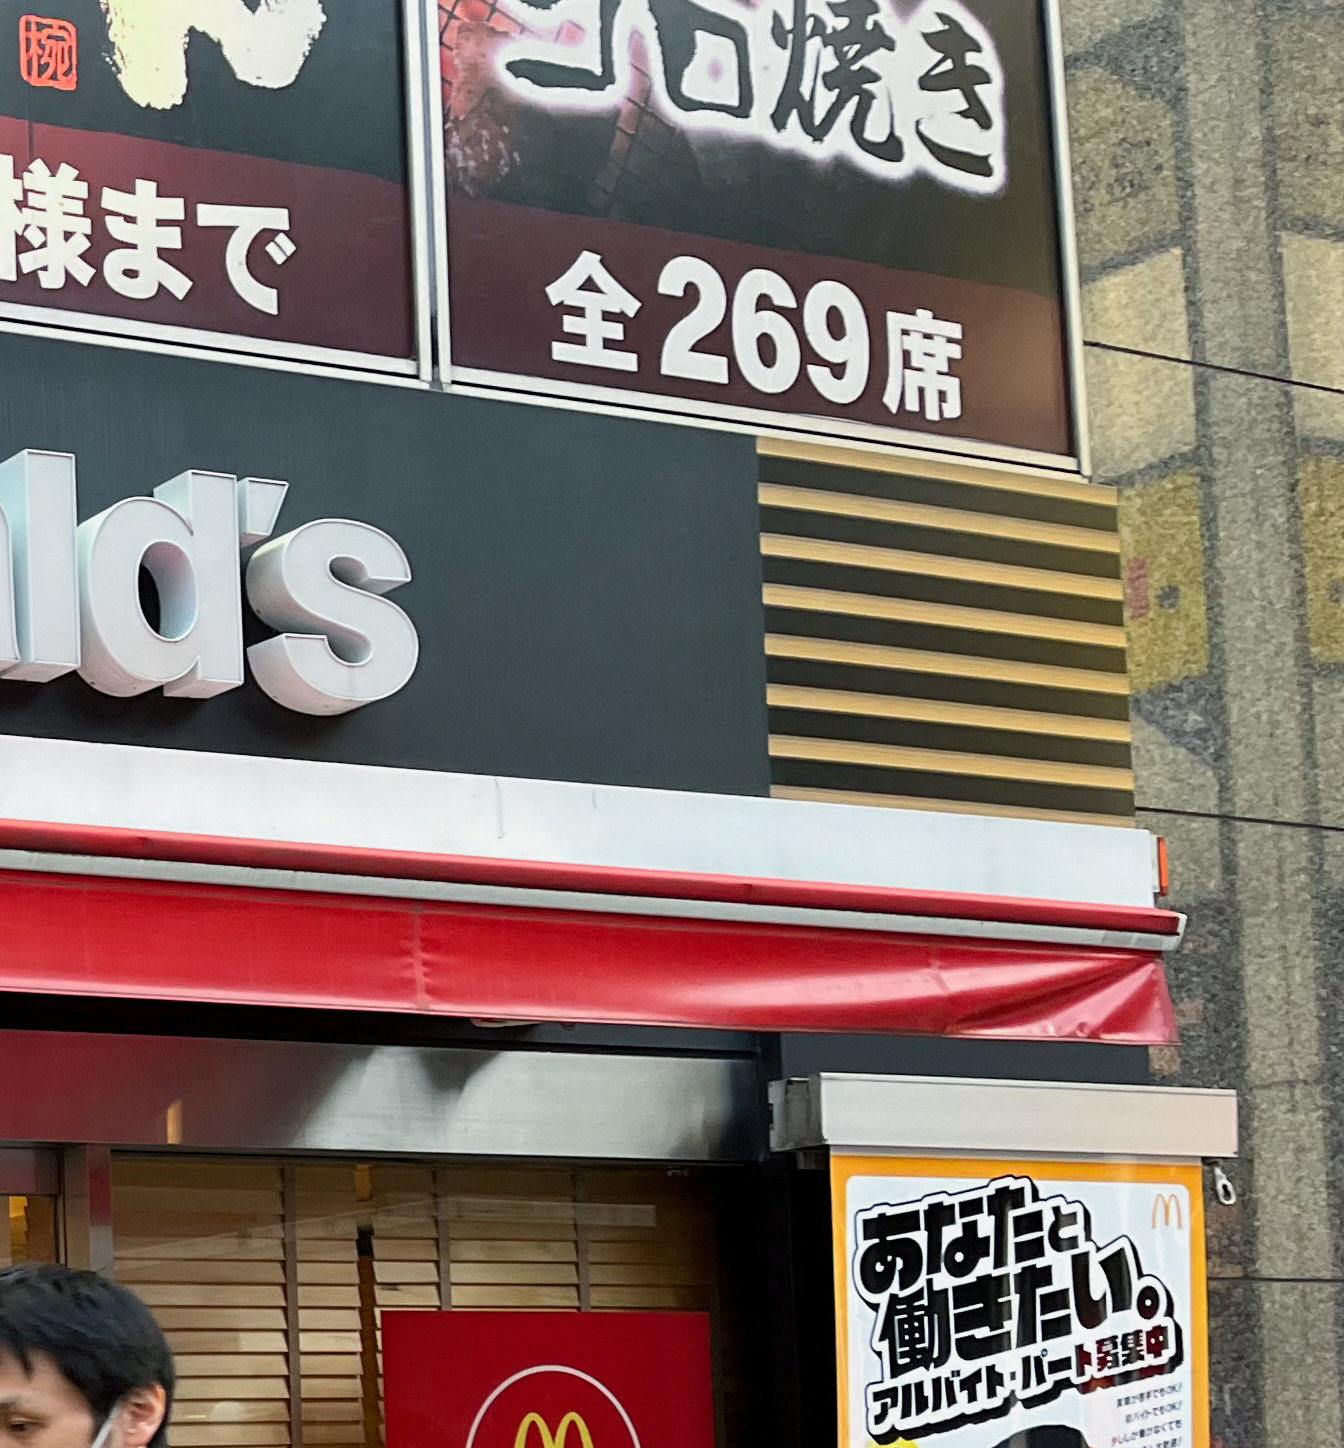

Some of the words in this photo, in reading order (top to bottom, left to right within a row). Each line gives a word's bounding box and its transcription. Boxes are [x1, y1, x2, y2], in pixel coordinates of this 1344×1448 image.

[543, 249, 966, 422] 全269席
[859, 1185, 1080, 1295] あなたと
[879, 1246, 1161, 1379] 働きたい。
